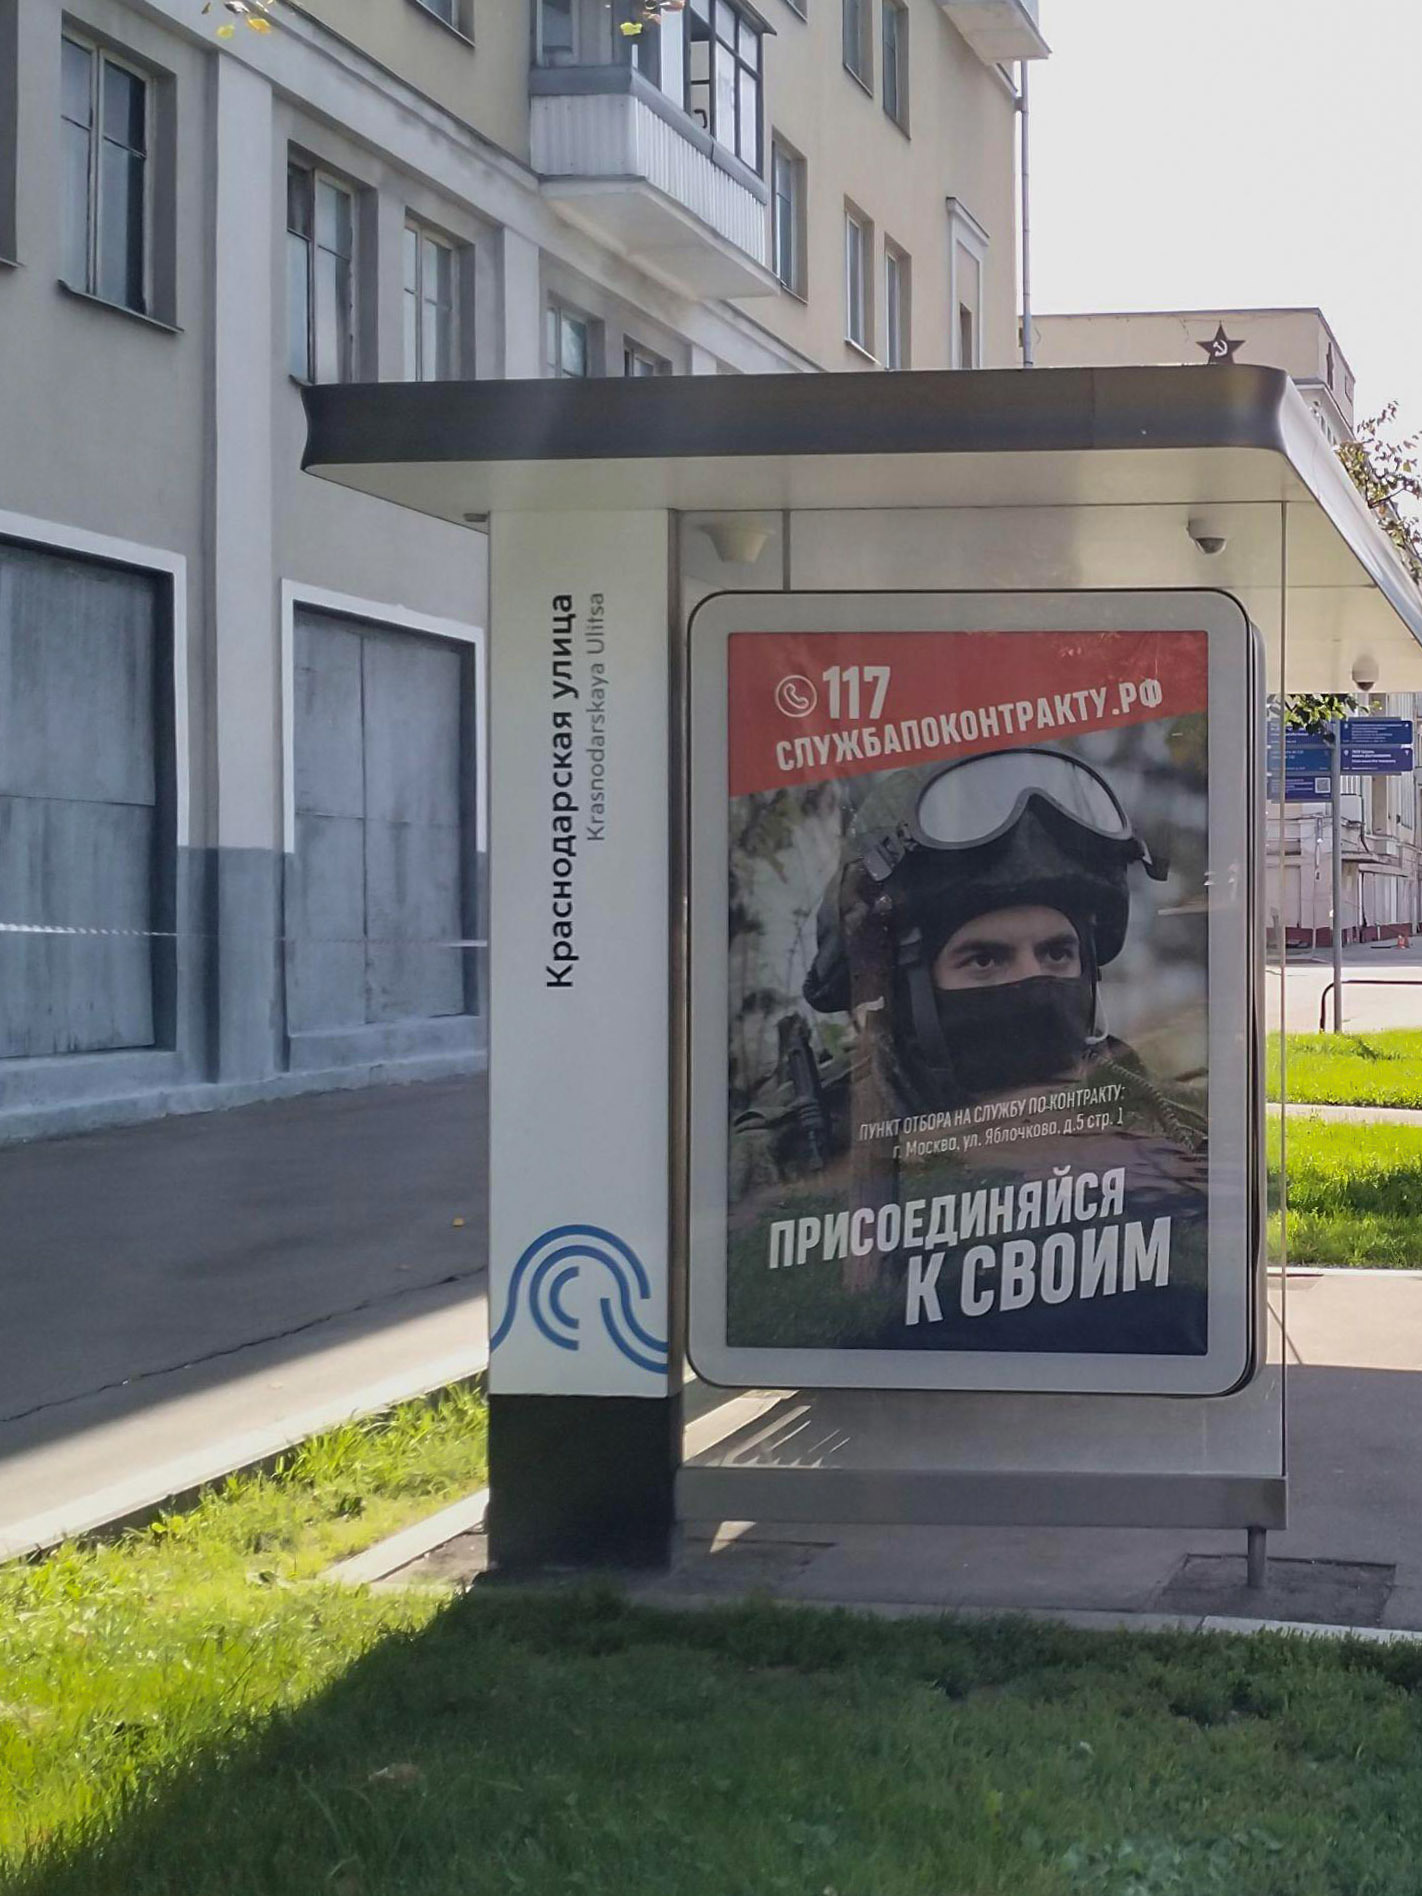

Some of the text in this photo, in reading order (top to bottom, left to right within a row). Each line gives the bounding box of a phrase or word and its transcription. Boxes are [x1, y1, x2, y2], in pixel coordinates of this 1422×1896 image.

[585, 592, 610, 841] Krasnodarskaya Ulitsa
[775, 678, 1164, 772] СЛУЖБАПОКОНТРАКТУ.РФ
[822, 664, 891, 720] 117
[546, 594, 579, 988] Краснодарская улица
[859, 1083, 1126, 1140] ПУНКТ ОТБОРА НА СЛУЖБУ ПО КОНТРАКТУ:
[892, 1145, 902, 1159] г.
[963, 1133, 982, 1152] ул.
[1087, 1112, 1113, 1131] стр.
[1117, 1106, 1123, 1125] 1
[769, 1164, 1126, 1269] ПРИСОЕДИНЯЙСЯ
[905, 1216, 1172, 1326] К СВОИМ
